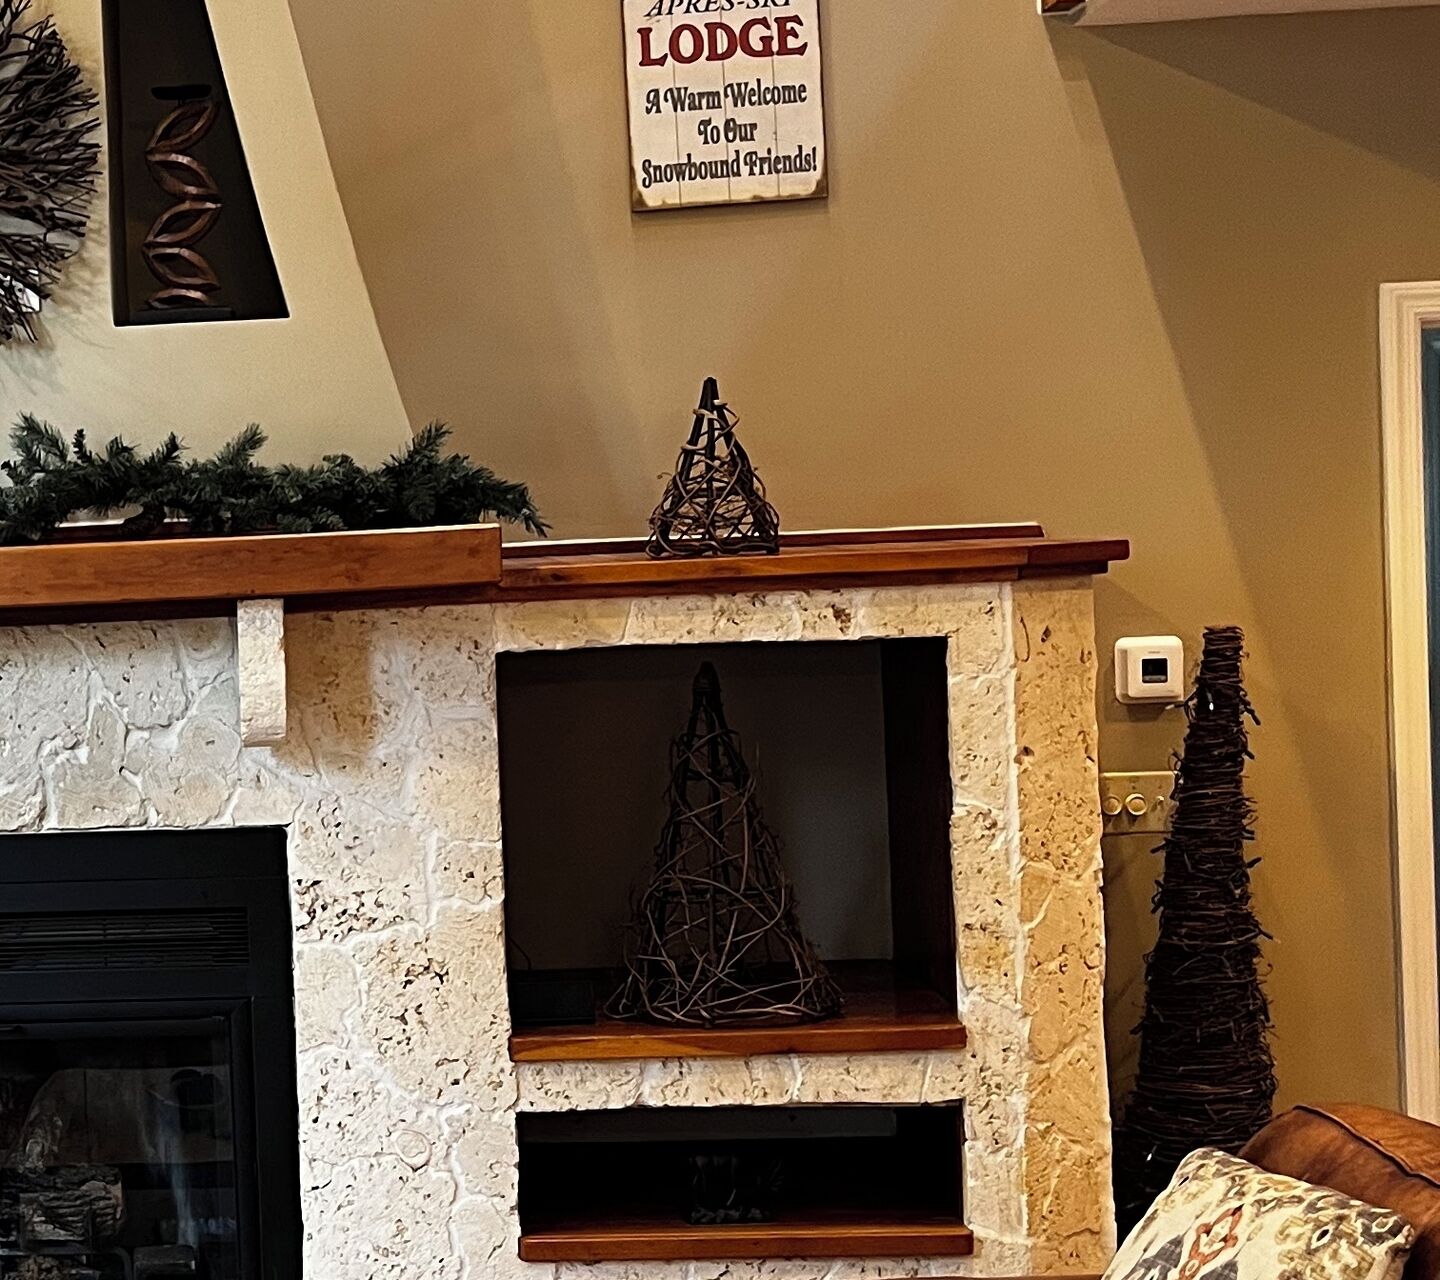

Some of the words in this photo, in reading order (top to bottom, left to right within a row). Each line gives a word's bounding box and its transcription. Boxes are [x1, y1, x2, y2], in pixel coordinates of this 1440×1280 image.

[637, 15, 808, 67] LODGE
[645, 88, 662, 115] A
[664, 86, 722, 113] Warm
[723, 78, 808, 108] Welcome
[698, 117, 721, 145] To
[724, 118, 758, 143] Our
[641, 150, 742, 189] Snowbound
[744, 144, 818, 177] Friends!
